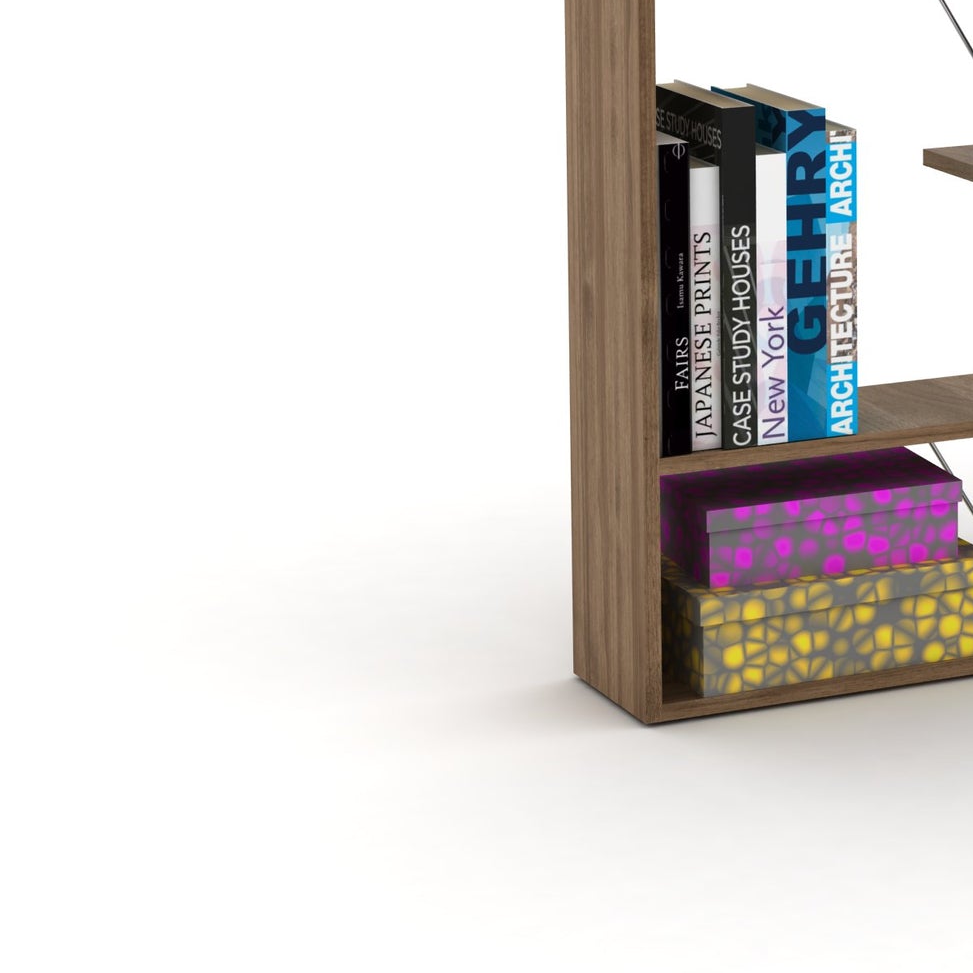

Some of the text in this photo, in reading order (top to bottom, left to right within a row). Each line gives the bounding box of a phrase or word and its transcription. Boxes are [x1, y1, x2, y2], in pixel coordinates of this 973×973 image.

[666, 111, 690, 136] STUDY
[691, 120, 722, 149] HOUSES
[830, 130, 852, 216] ARCHI
[676, 284, 684, 309] Isamu
[786, 108, 826, 355] GEHRY
[674, 336, 689, 391] FAIRS
[694, 232, 718, 438] JAPANESE PRINTS
[732, 225, 752, 446] CASE STUDY HOUSES
[759, 306, 785, 439] New York
[830, 234, 854, 434] ARCHITECTURE
